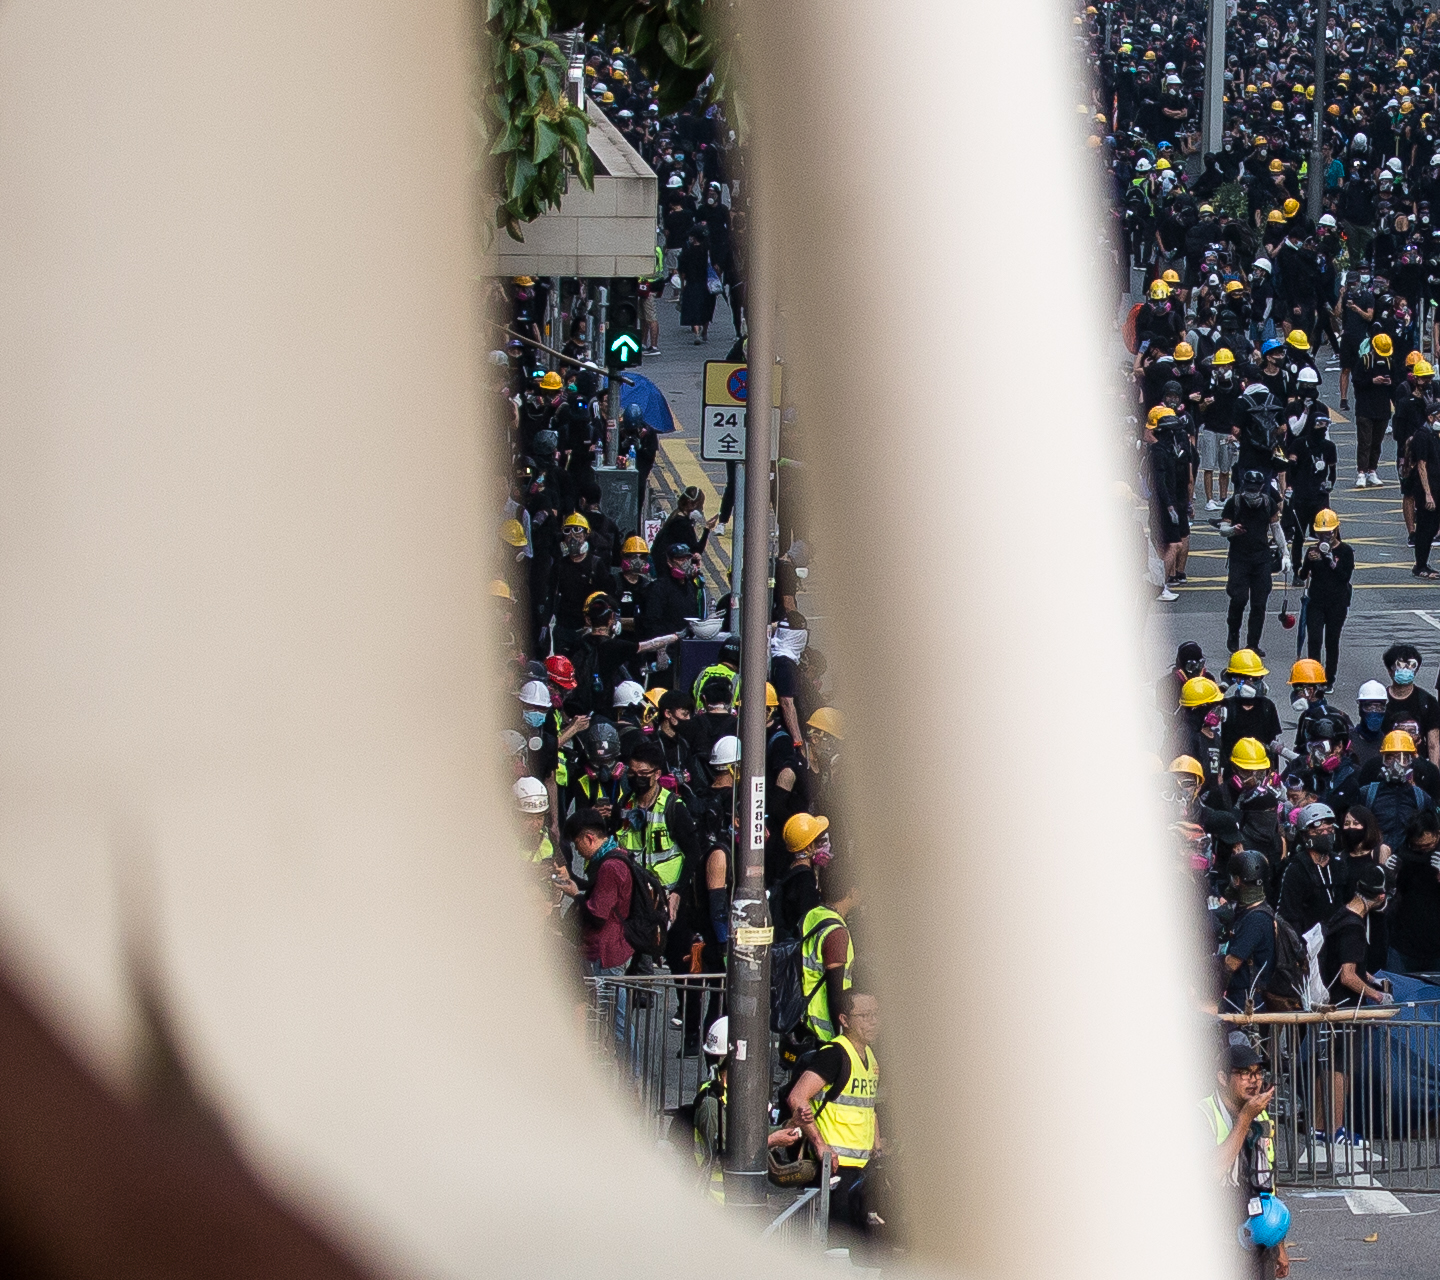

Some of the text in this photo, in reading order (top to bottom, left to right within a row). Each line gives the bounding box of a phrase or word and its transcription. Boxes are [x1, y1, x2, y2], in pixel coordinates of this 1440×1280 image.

[713, 412, 738, 427] 24
[717, 433, 740, 454] 全
[851, 1077, 878, 1095] PRES
